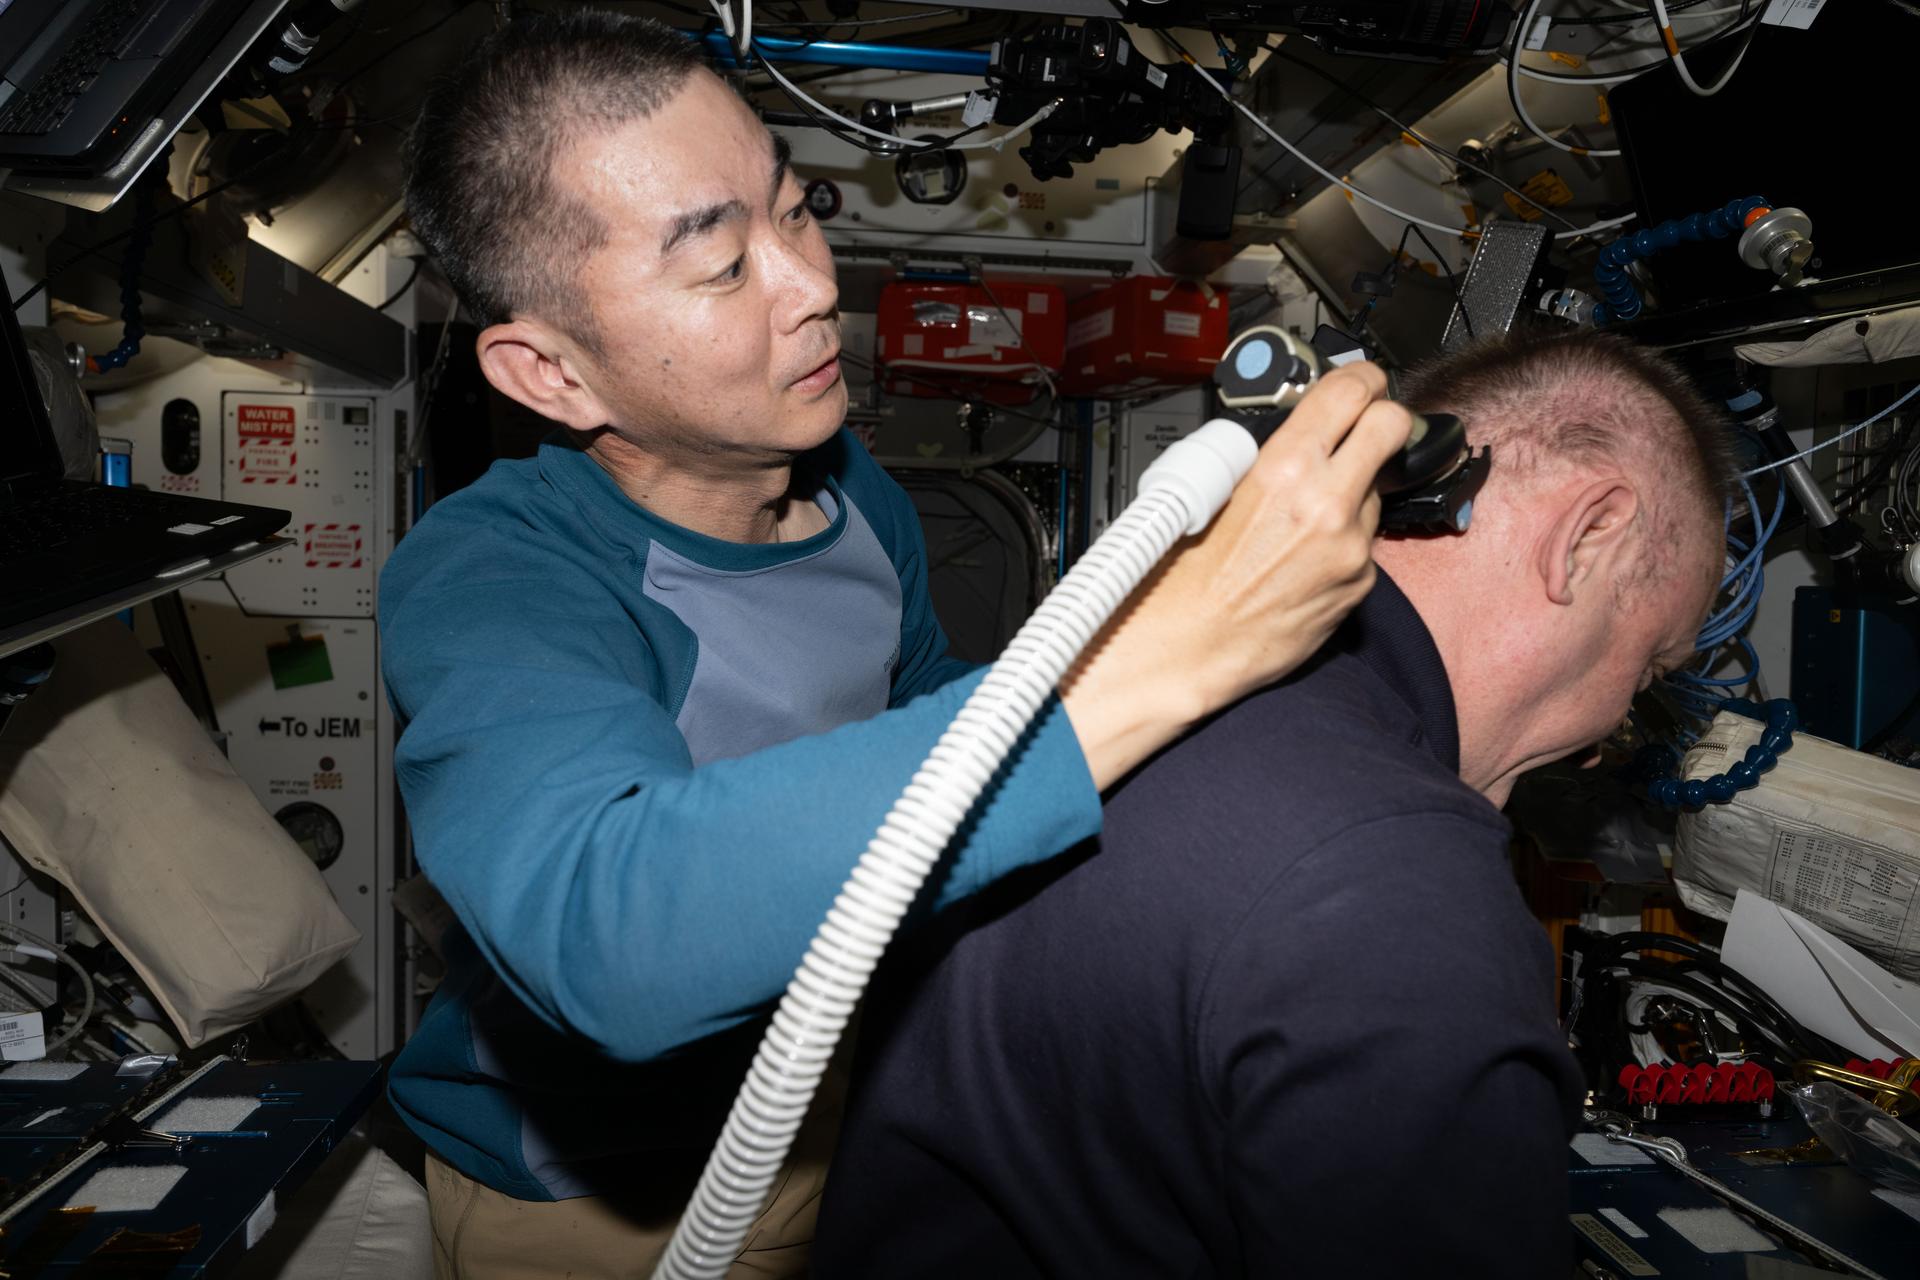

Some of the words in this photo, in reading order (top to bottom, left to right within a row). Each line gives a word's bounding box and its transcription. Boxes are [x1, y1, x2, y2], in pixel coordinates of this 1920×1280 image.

[244, 408, 289, 421] WATER
[240, 421, 269, 432] MIST
[271, 422, 294, 434] PFE
[281, 717, 308, 737] To
[314, 717, 360, 737] JEM
